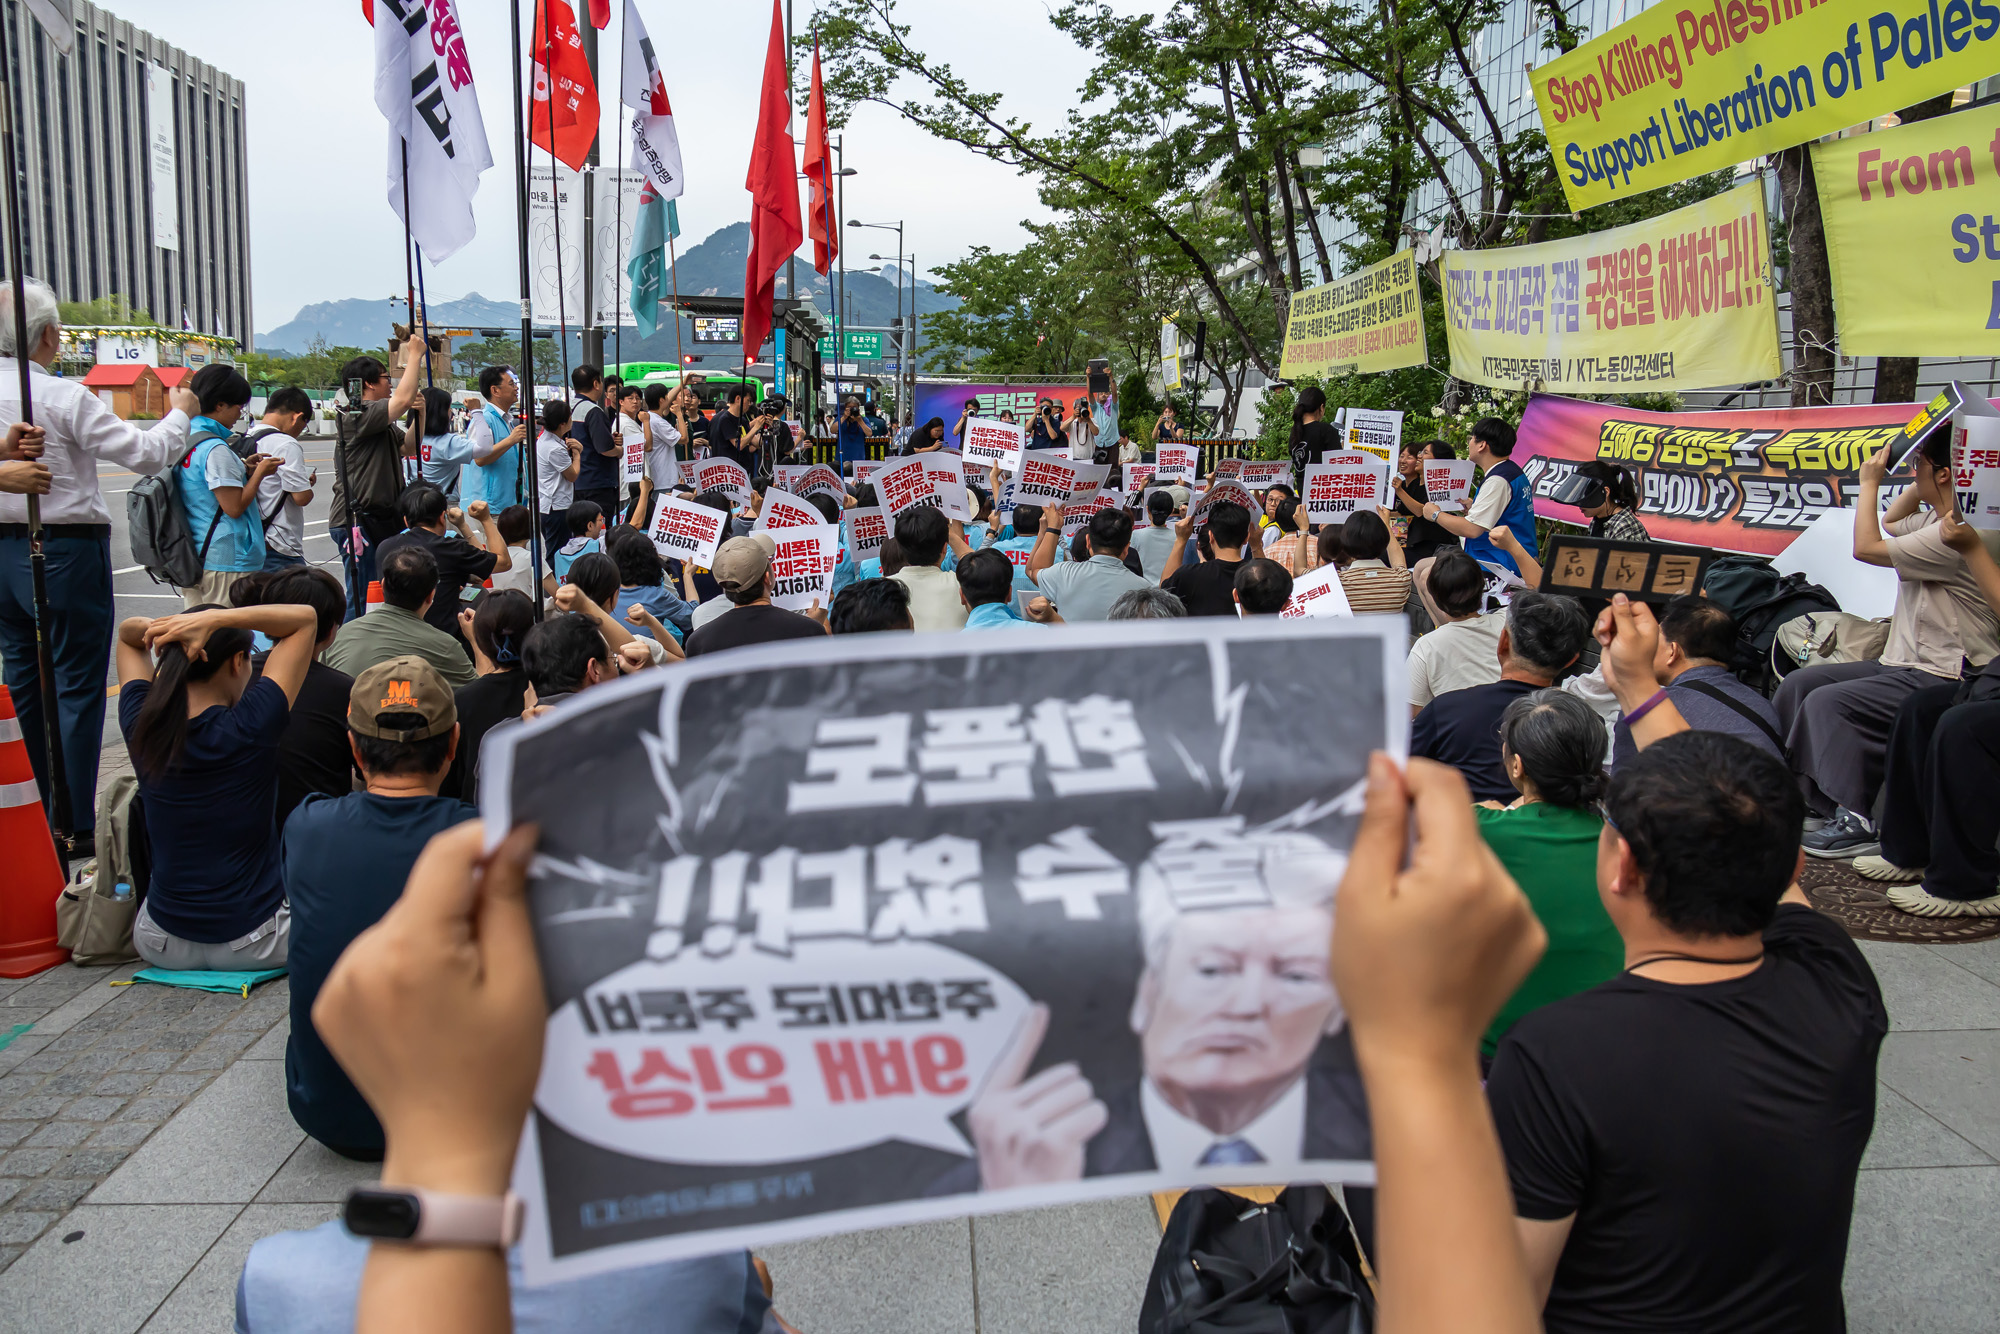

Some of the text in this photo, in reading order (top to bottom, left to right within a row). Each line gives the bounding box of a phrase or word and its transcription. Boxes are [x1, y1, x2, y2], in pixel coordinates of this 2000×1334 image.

[1546, 73, 1602, 124] Stop
[1597, 34, 1684, 101] Killing
[1564, 114, 1667, 190] Support
[1660, 63, 1817, 157] Liberation
[1822, 22, 1863, 99] of
[1857, 145, 1975, 202] From
[1391, 257, 1412, 287] 국정원!
[1494, 263, 1547, 336] 파괴공작
[1551, 257, 1580, 333] 주범
[1585, 242, 1656, 331] 국정원을
[1658, 211, 1763, 322] 해체하라!!
[1379, 293, 1403, 324] 통신재벌
[1404, 288, 1416, 315] KT!
[1394, 318, 1418, 346] 나라냐?
[115, 348, 140, 360] LIG
[1482, 351, 1676, 384] KT전국민주동지회 / KT노동인권센터
[975, 392, 1037, 415] 트럼프
[971, 426, 1019, 441] 식량주권훼손
[1597, 420, 1670, 463] 김혜경
[1660, 428, 1775, 468] 김정숙도
[968, 446, 1005, 460] 저지하자!
[970, 437, 1019, 452] 위생검역훼손
[1159, 465, 1186, 474] 저지하자!
[1969, 450, 2000, 469] 주둔
[881, 461, 923, 489] 중국견제
[1022, 471, 1098, 492] 경제주권 침해
[1024, 460, 1076, 482] 관세폭탄
[1243, 475, 1272, 483] 저지하자!
[1311, 473, 1377, 487] 식량주권훼손
[1426, 468, 1451, 480] 관세폭탄
[885, 470, 957, 500] 주한미군 주둔비
[1019, 483, 1071, 502] 저지하자!
[1309, 486, 1375, 499] 위생검역훼손
[1427, 479, 1466, 491] 경제주권 침해
[1638, 471, 1737, 519] 만이나?
[888, 482, 935, 514] 10배 인상
[1308, 500, 1355, 512] 저지하자!
[661, 505, 719, 531] 식량주권훼손
[654, 530, 699, 552] 저지하자!
[657, 518, 716, 543] 위생검역훼손
[774, 539, 820, 559] 세폭탄
[772, 557, 822, 578] 제주권
[1296, 583, 1331, 604] 주둔비
[388, 681, 411, 698] M
[381, 697, 418, 708] EXPLORE
